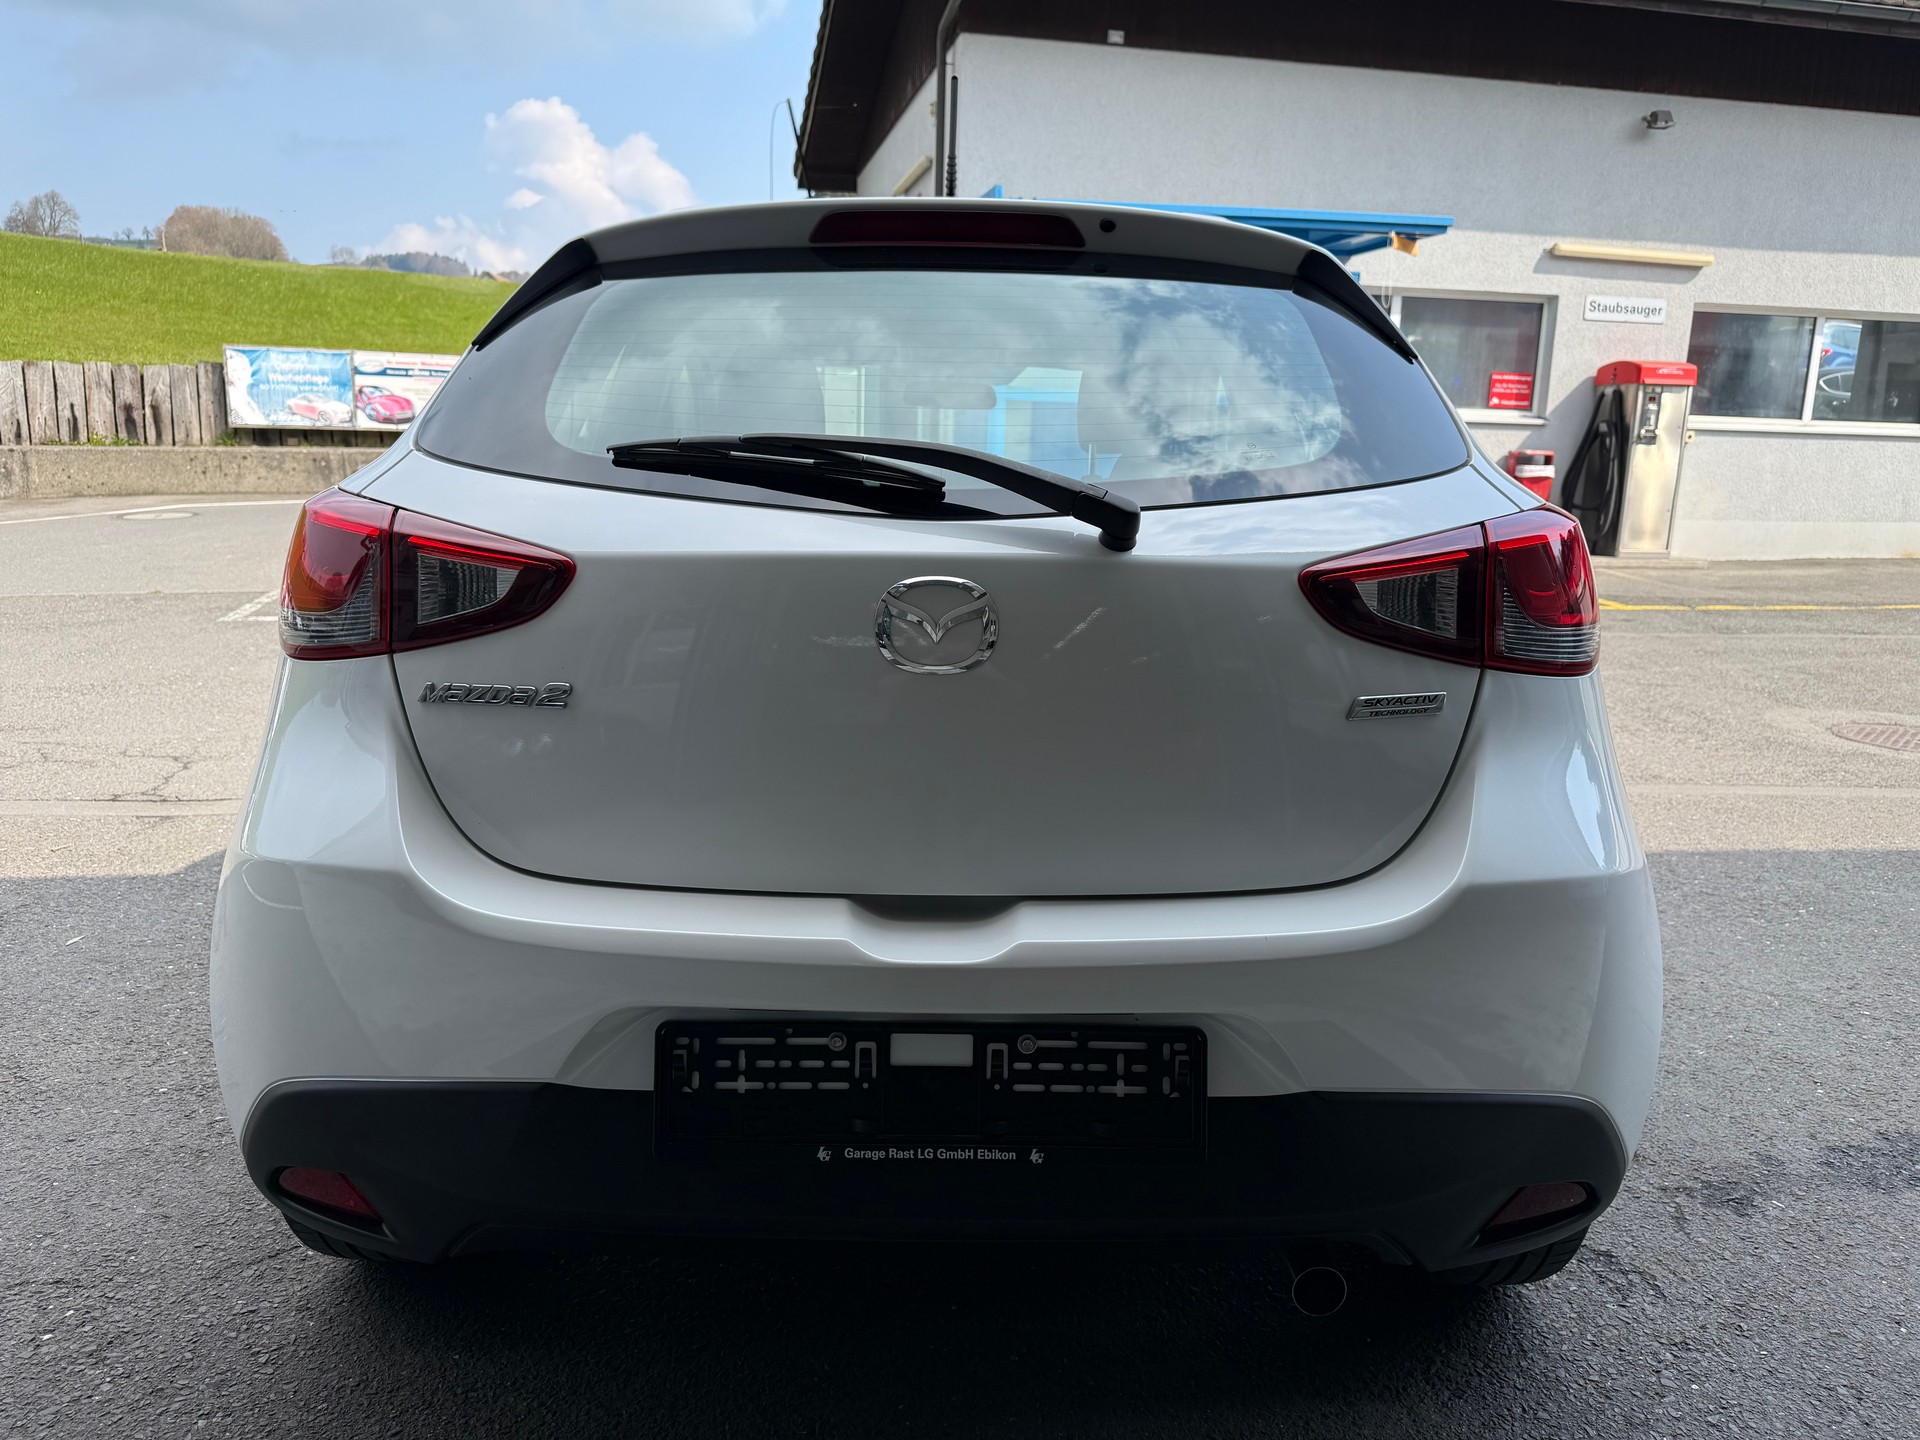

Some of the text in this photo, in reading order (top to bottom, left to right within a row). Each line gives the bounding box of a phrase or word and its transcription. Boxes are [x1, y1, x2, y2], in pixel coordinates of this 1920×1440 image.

[1588, 300, 1663, 318] Staubsauger
[1361, 695, 1439, 708] SKYACTIV
[1368, 707, 1430, 717] TECHNOLOGY
[844, 1147, 886, 1160] Garage
[888, 1148, 915, 1159] Rast
[917, 1148, 934, 1159] LG
[937, 1148, 974, 1160] GmbH
[977, 1148, 1017, 1160] Ebikon
